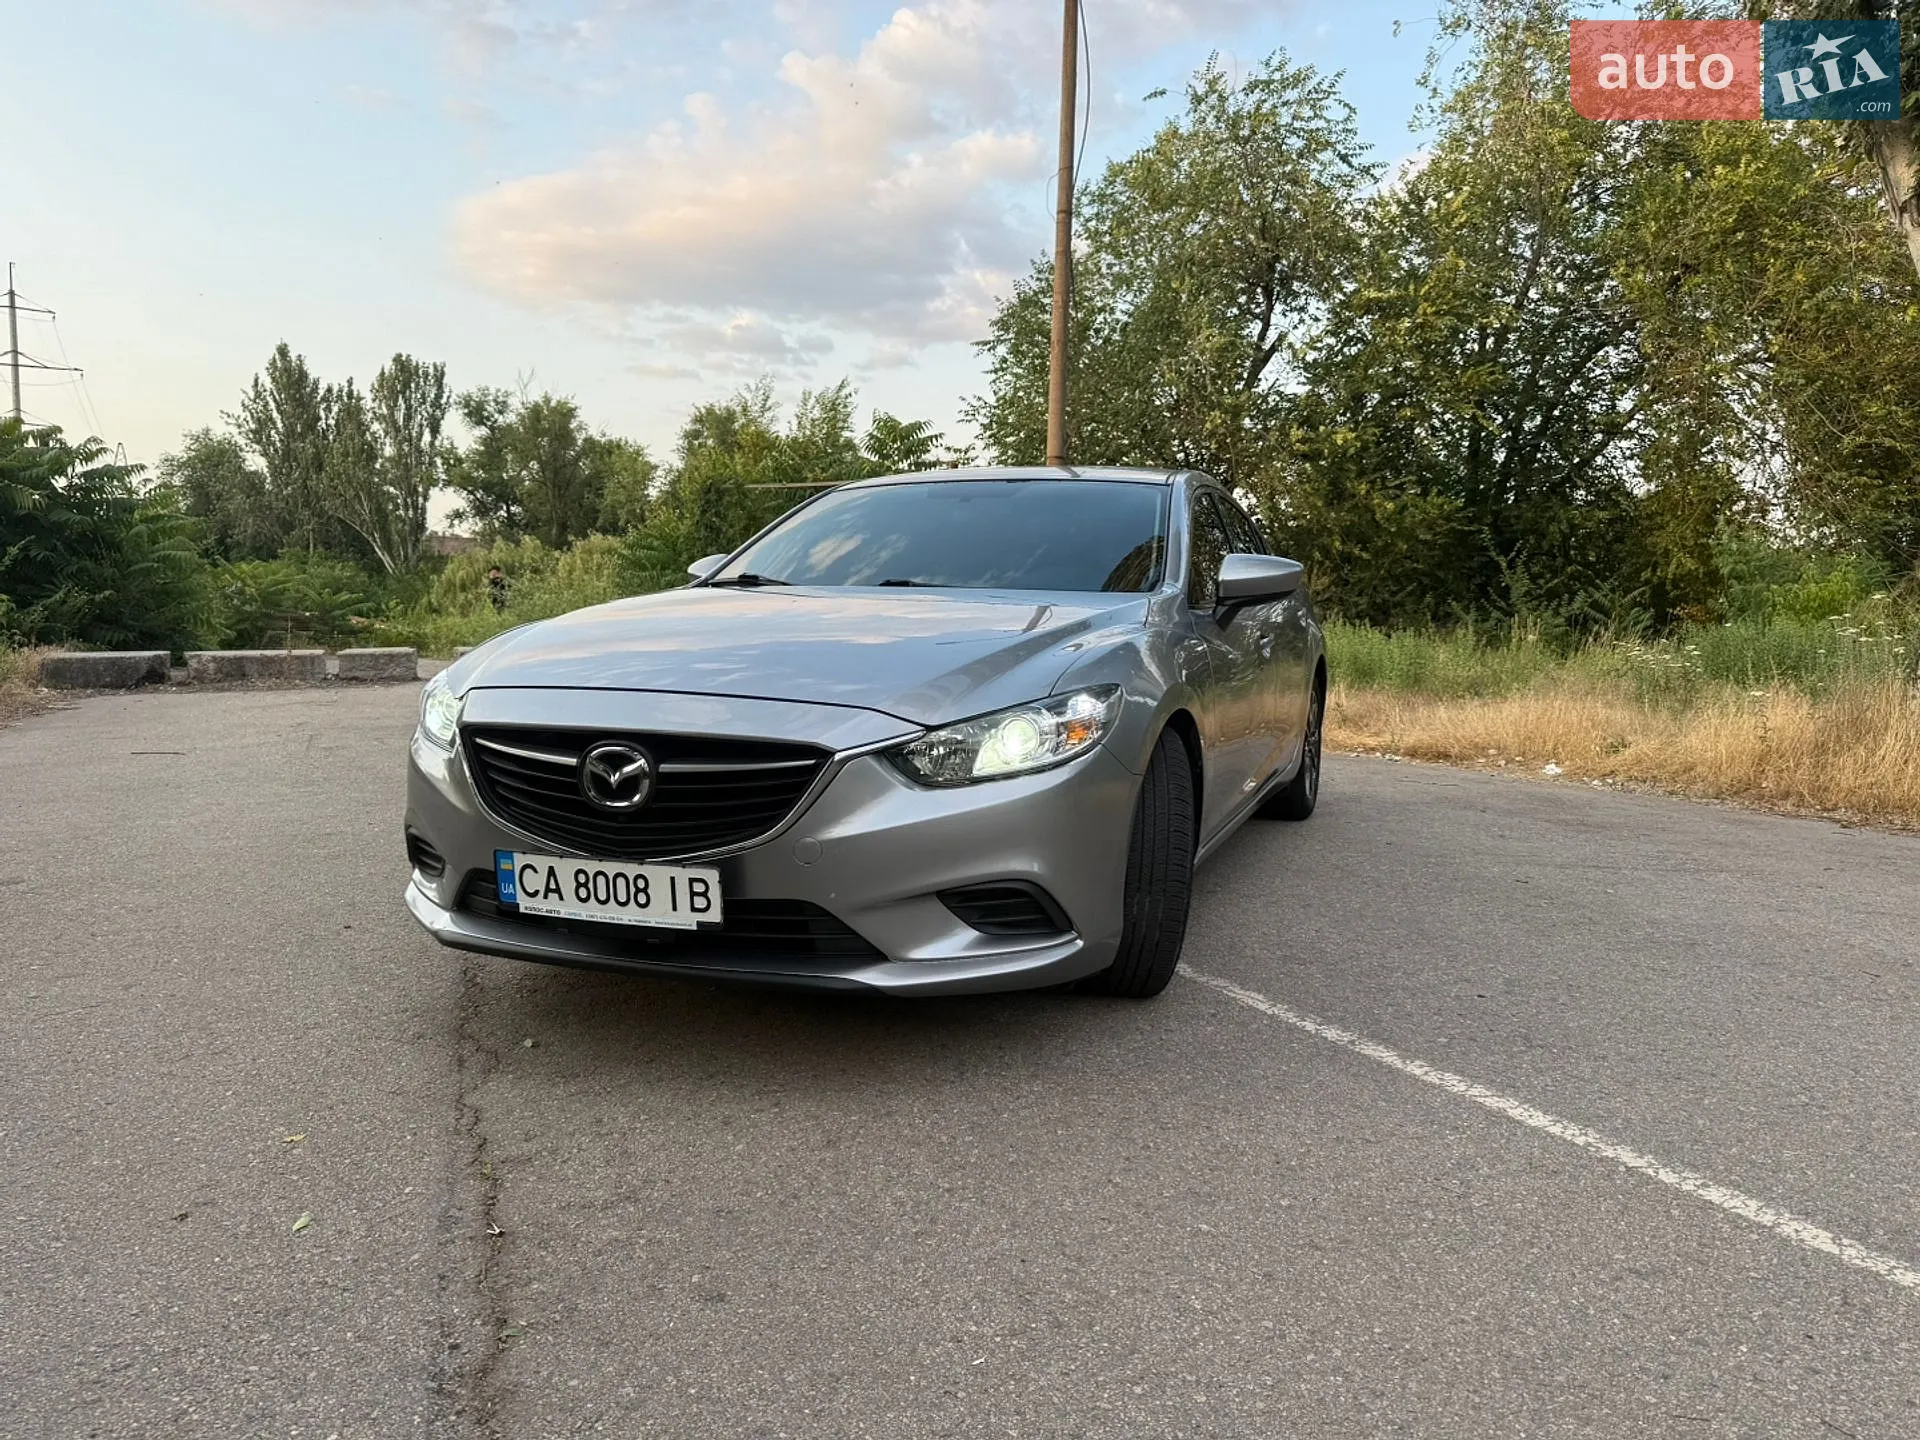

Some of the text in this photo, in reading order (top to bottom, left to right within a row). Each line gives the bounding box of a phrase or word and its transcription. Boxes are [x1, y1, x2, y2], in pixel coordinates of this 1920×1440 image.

[501, 882, 515, 895] UA
[518, 863, 712, 913] CA 8008 IB
